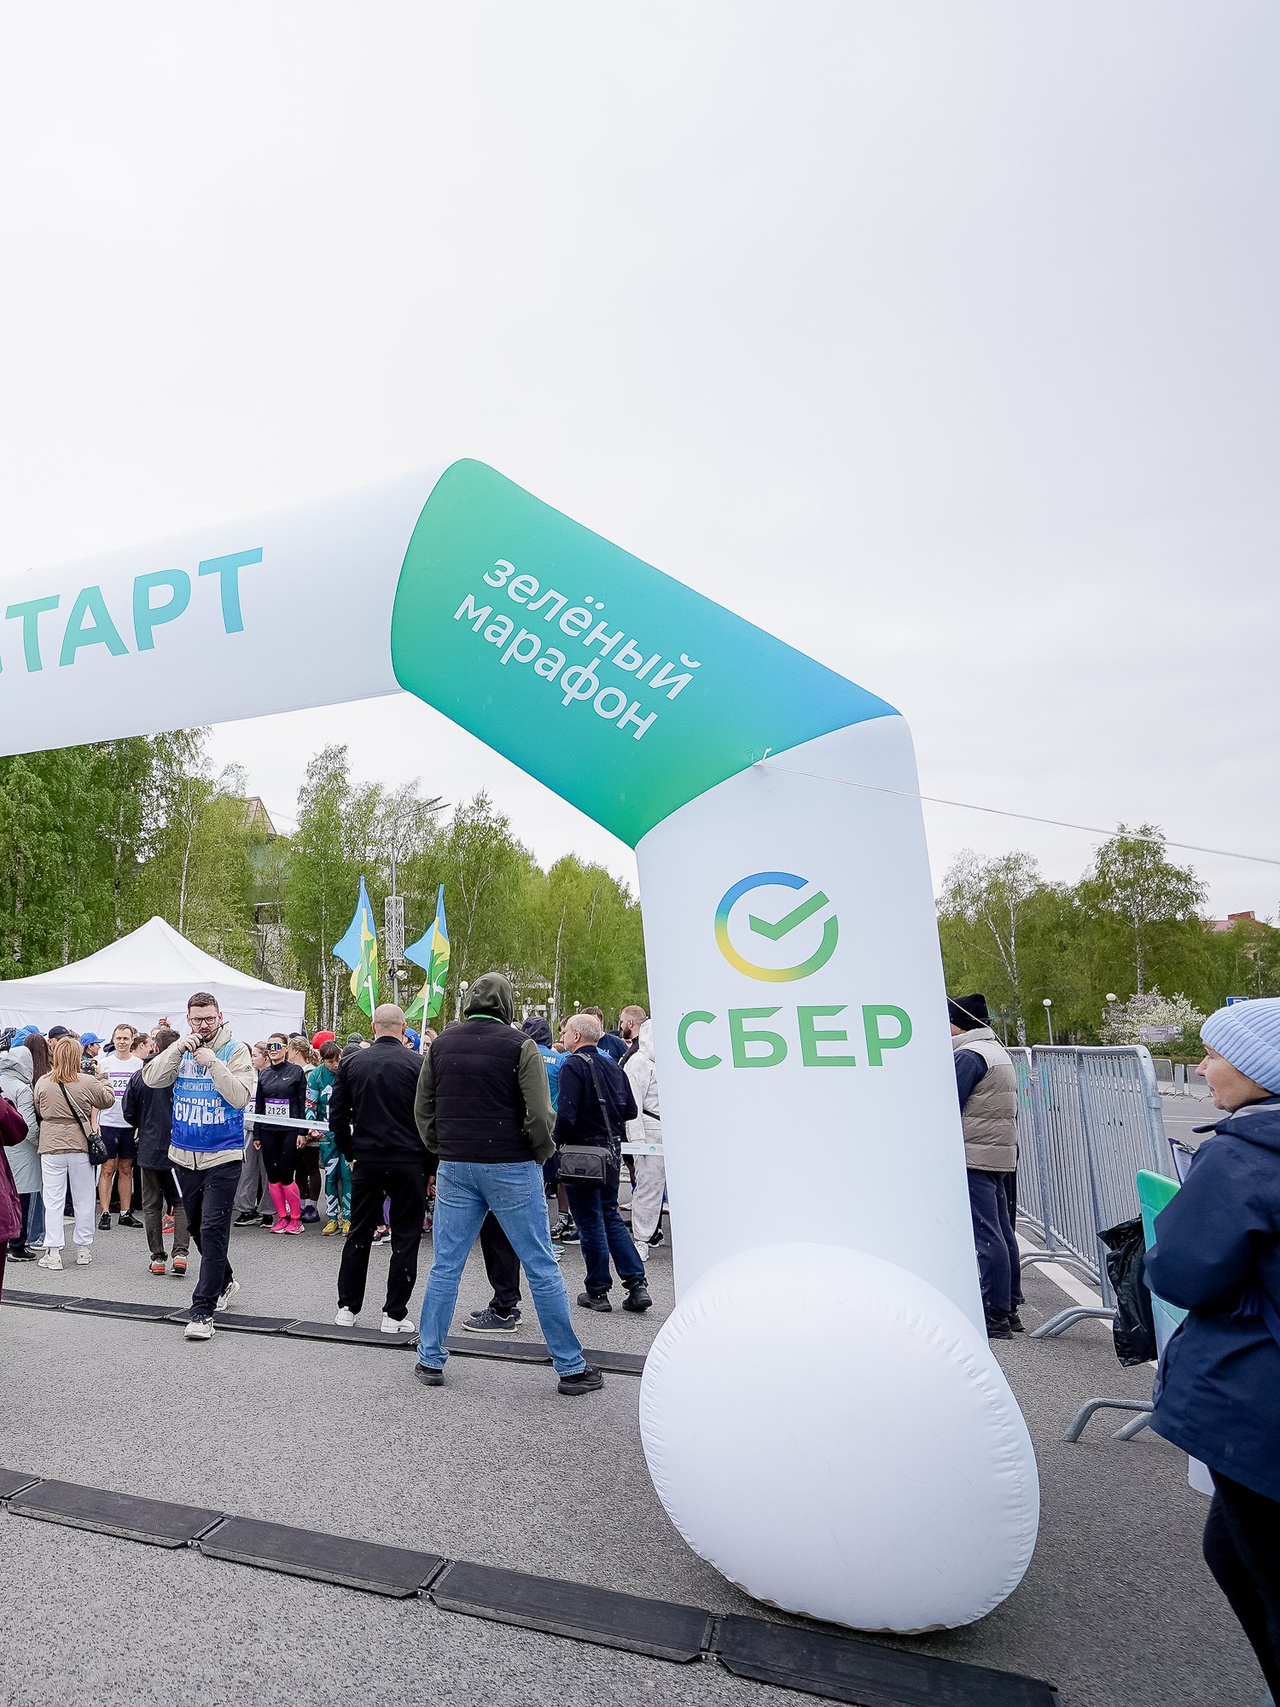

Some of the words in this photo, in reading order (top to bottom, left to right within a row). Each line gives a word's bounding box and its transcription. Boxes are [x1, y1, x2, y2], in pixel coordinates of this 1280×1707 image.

[482, 558, 702, 700] зелёный
[453, 593, 659, 741] марафон
[677, 1004, 913, 1070] СБЕР
[113, 1079, 128, 1088] 225
[175, 1102, 225, 1127] СУДЬЯ
